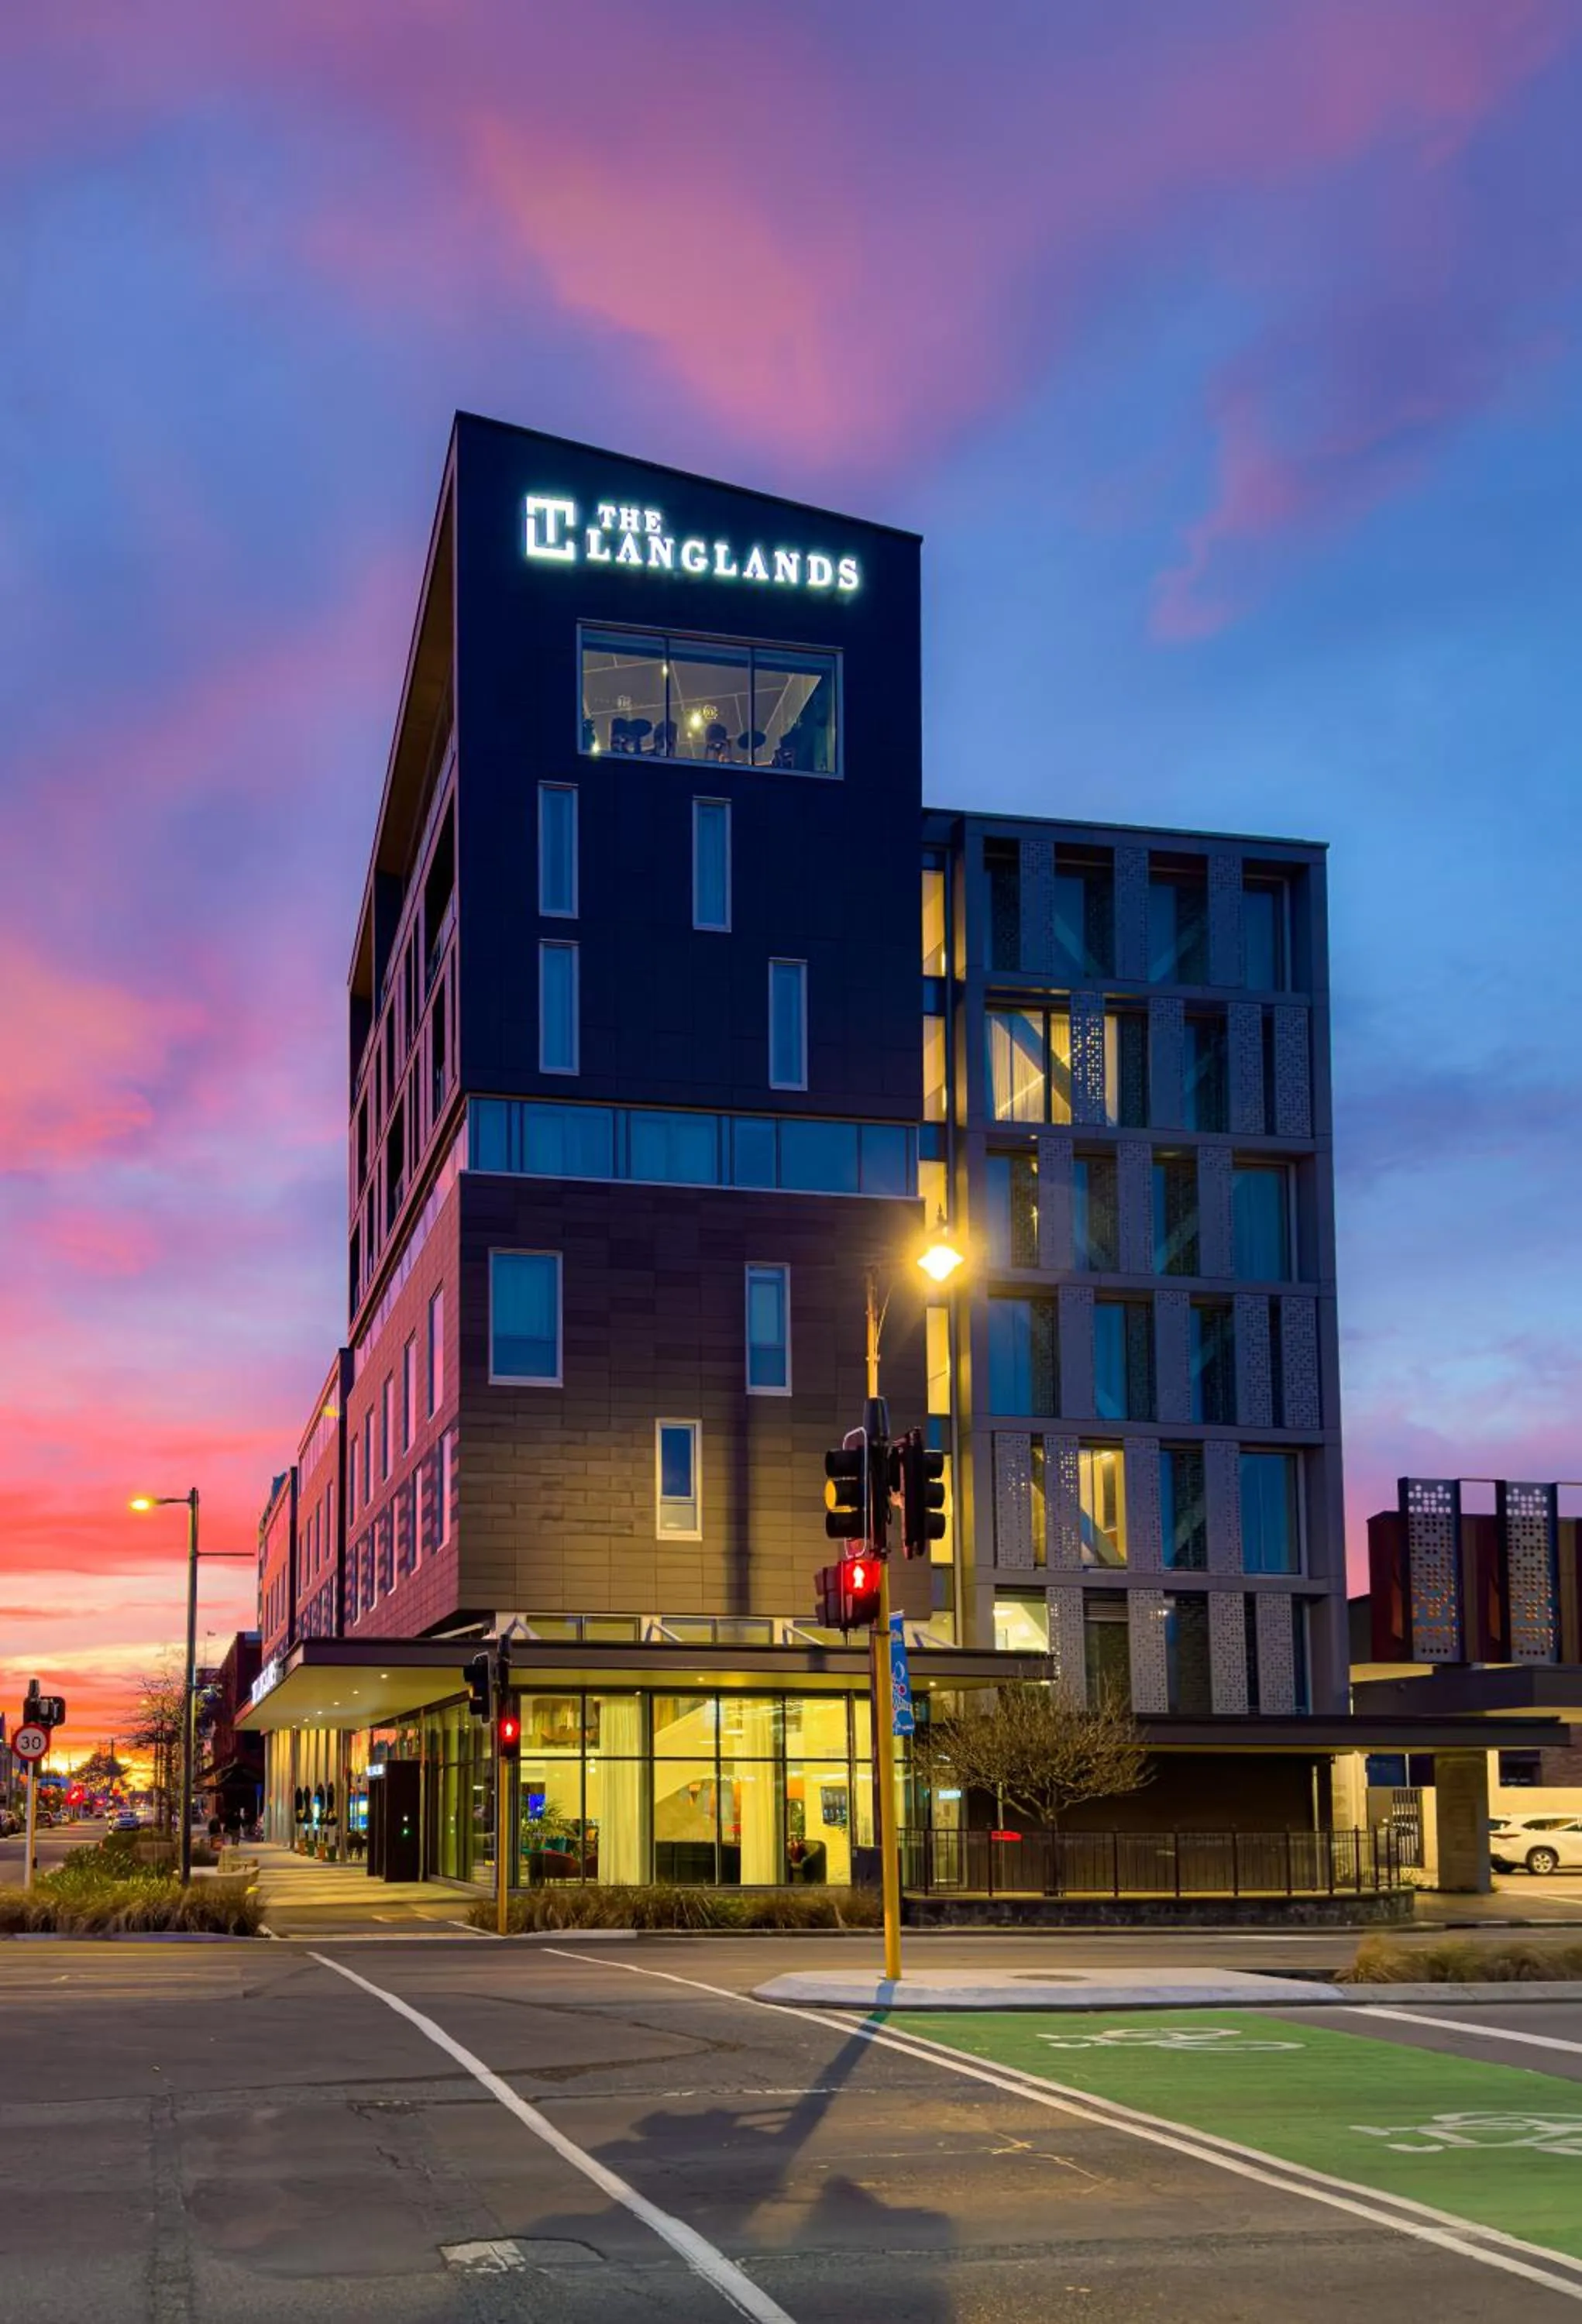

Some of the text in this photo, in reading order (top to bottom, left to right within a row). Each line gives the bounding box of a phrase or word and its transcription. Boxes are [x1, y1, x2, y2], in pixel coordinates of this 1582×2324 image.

[597, 504, 662, 533] THE
[586, 528, 859, 590] LANGLANDS
[21, 1735, 41, 1750] 30
